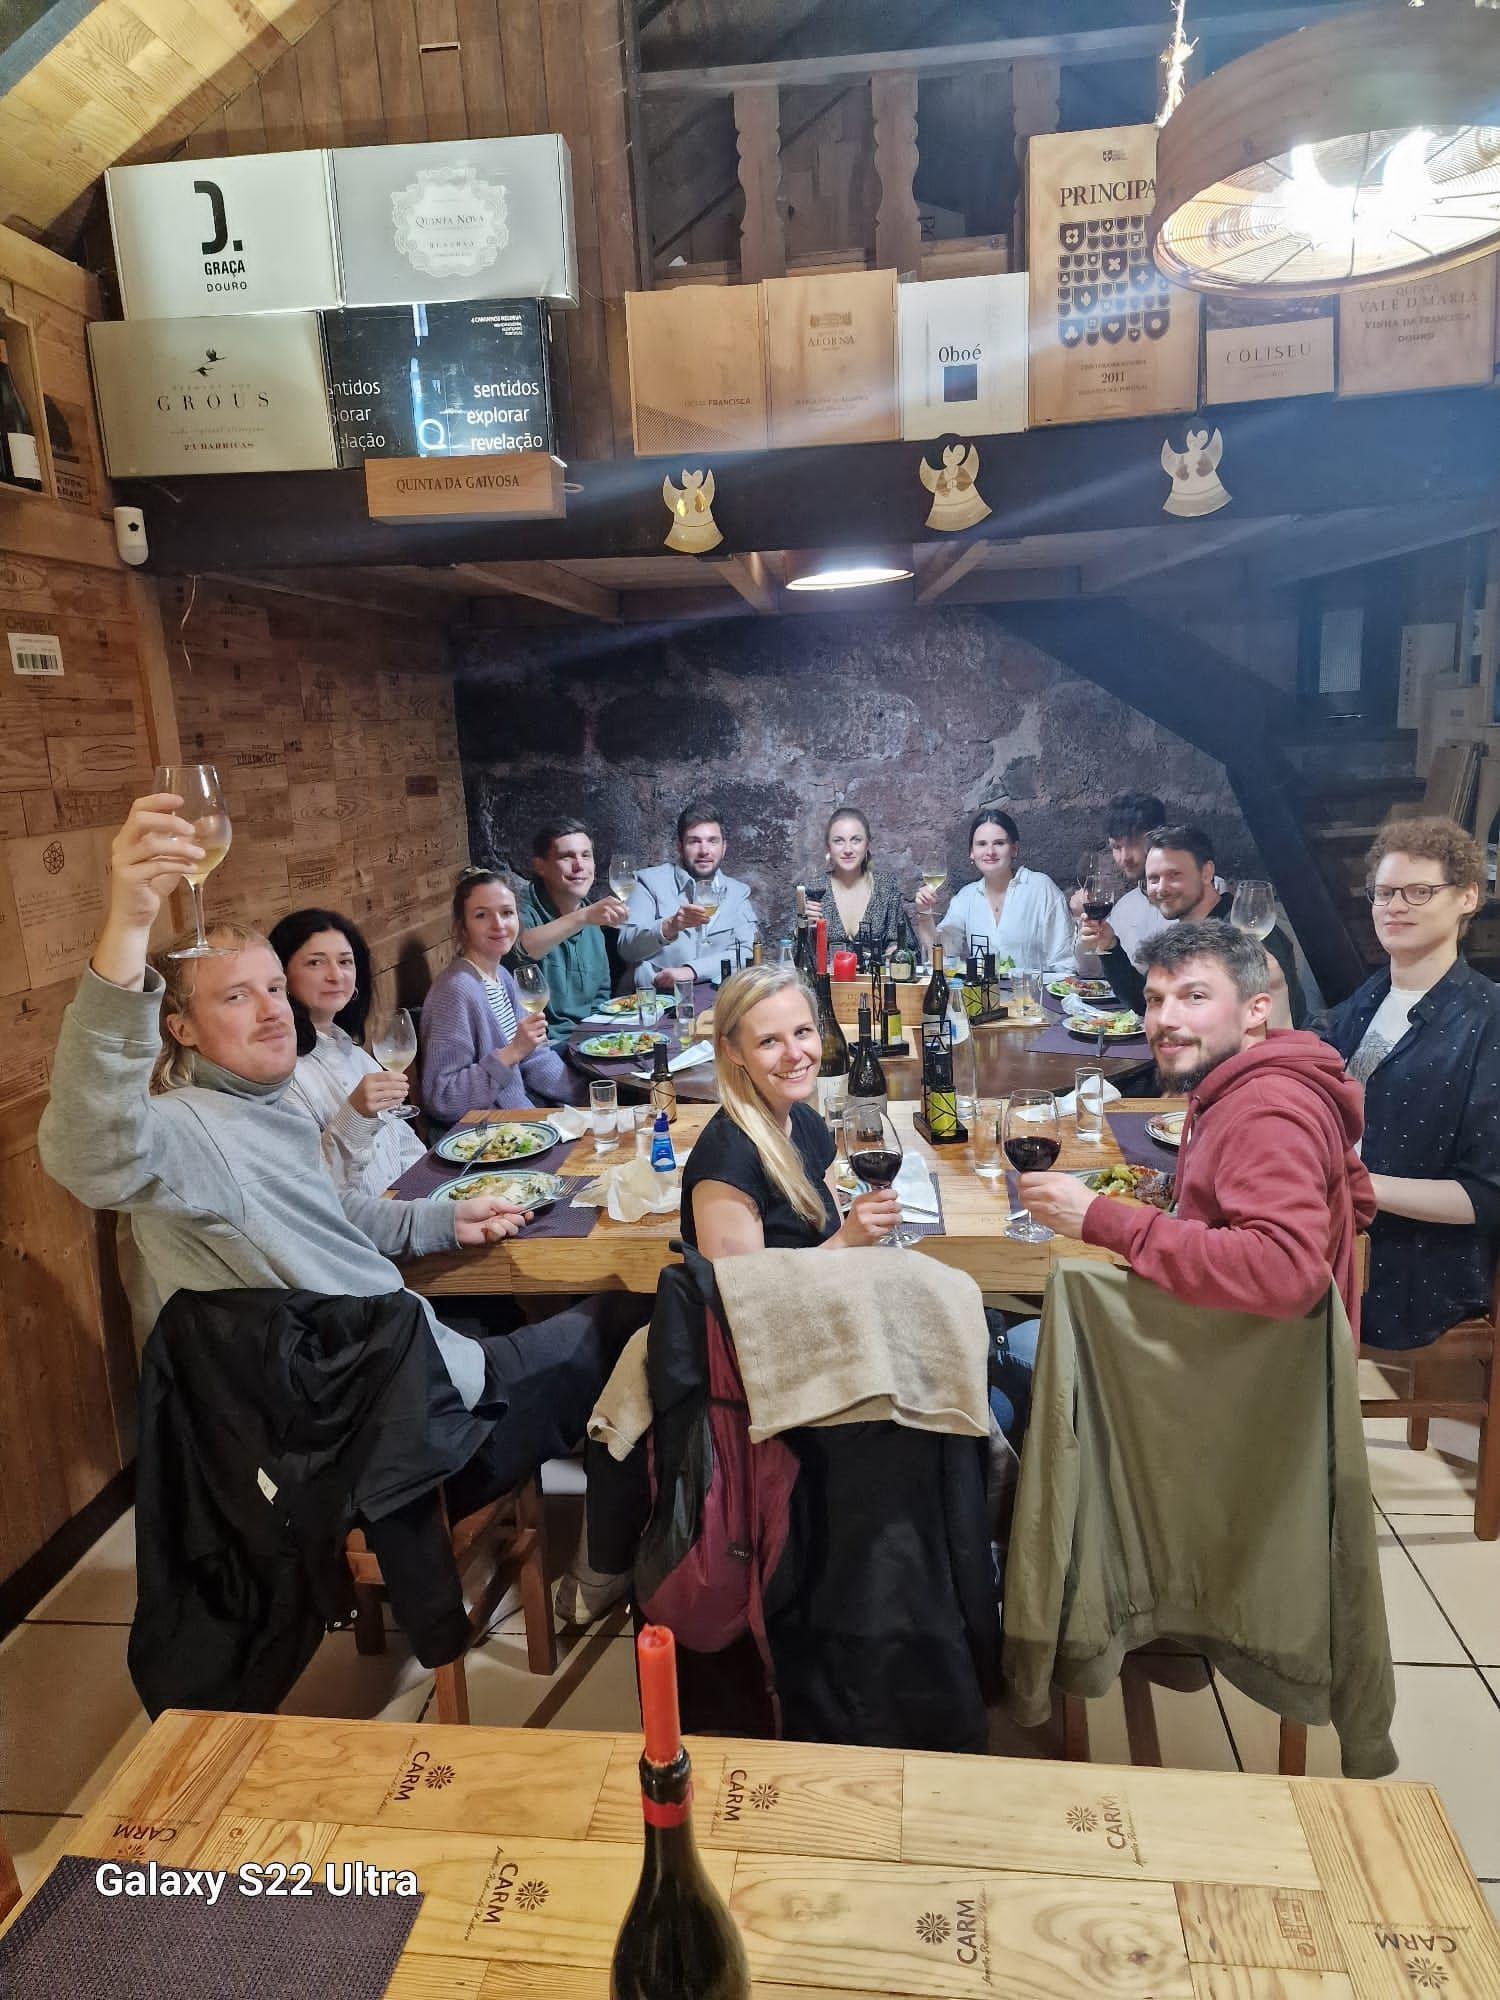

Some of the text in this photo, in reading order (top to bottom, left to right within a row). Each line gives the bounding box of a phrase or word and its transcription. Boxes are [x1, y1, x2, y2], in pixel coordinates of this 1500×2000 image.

[204, 260, 246, 278] GRAÇA
[206, 281, 248, 292] DOURO
[938, 344, 983, 363] Oboé
[1226, 343, 1312, 364] COLISEU
[473, 380, 540, 398] sentidos
[157, 391, 270, 412] GROUS
[466, 406, 531, 428] explorar
[471, 432, 543, 452] revelação
[396, 474, 520, 495] QUINTA DA GAIVOSA
[391, 1751, 430, 1801] CARM
[723, 1769, 748, 1821] CARM
[113, 1823, 177, 1842] CARM
[1101, 1795, 1126, 1850] CARM
[482, 1862, 519, 1923] CARM
[956, 1899, 978, 1965] CARM
[1374, 1931, 1457, 1954] CARM
